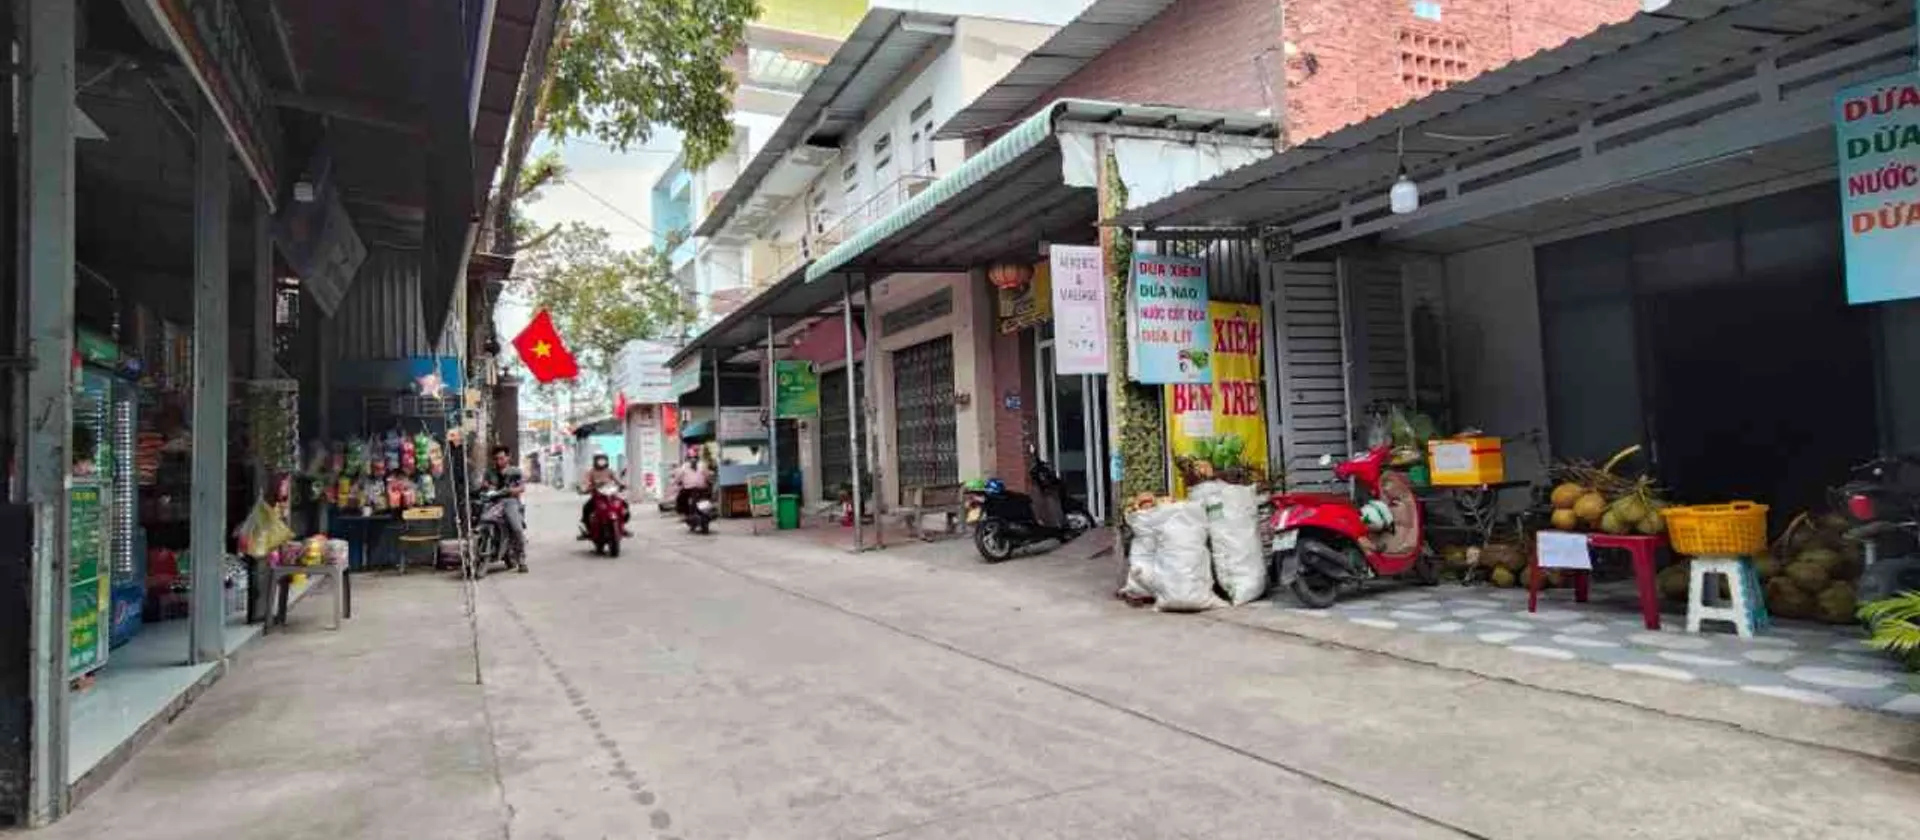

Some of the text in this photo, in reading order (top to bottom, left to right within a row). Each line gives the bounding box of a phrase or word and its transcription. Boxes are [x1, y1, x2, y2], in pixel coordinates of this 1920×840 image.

[1844, 85, 1920, 122] DỪA
[1846, 123, 1920, 160] DỪA
[1848, 162, 1919, 197] NƯỚC
[1213, 310, 1258, 357] XIÊM
[1219, 381, 1259, 415] TRE
